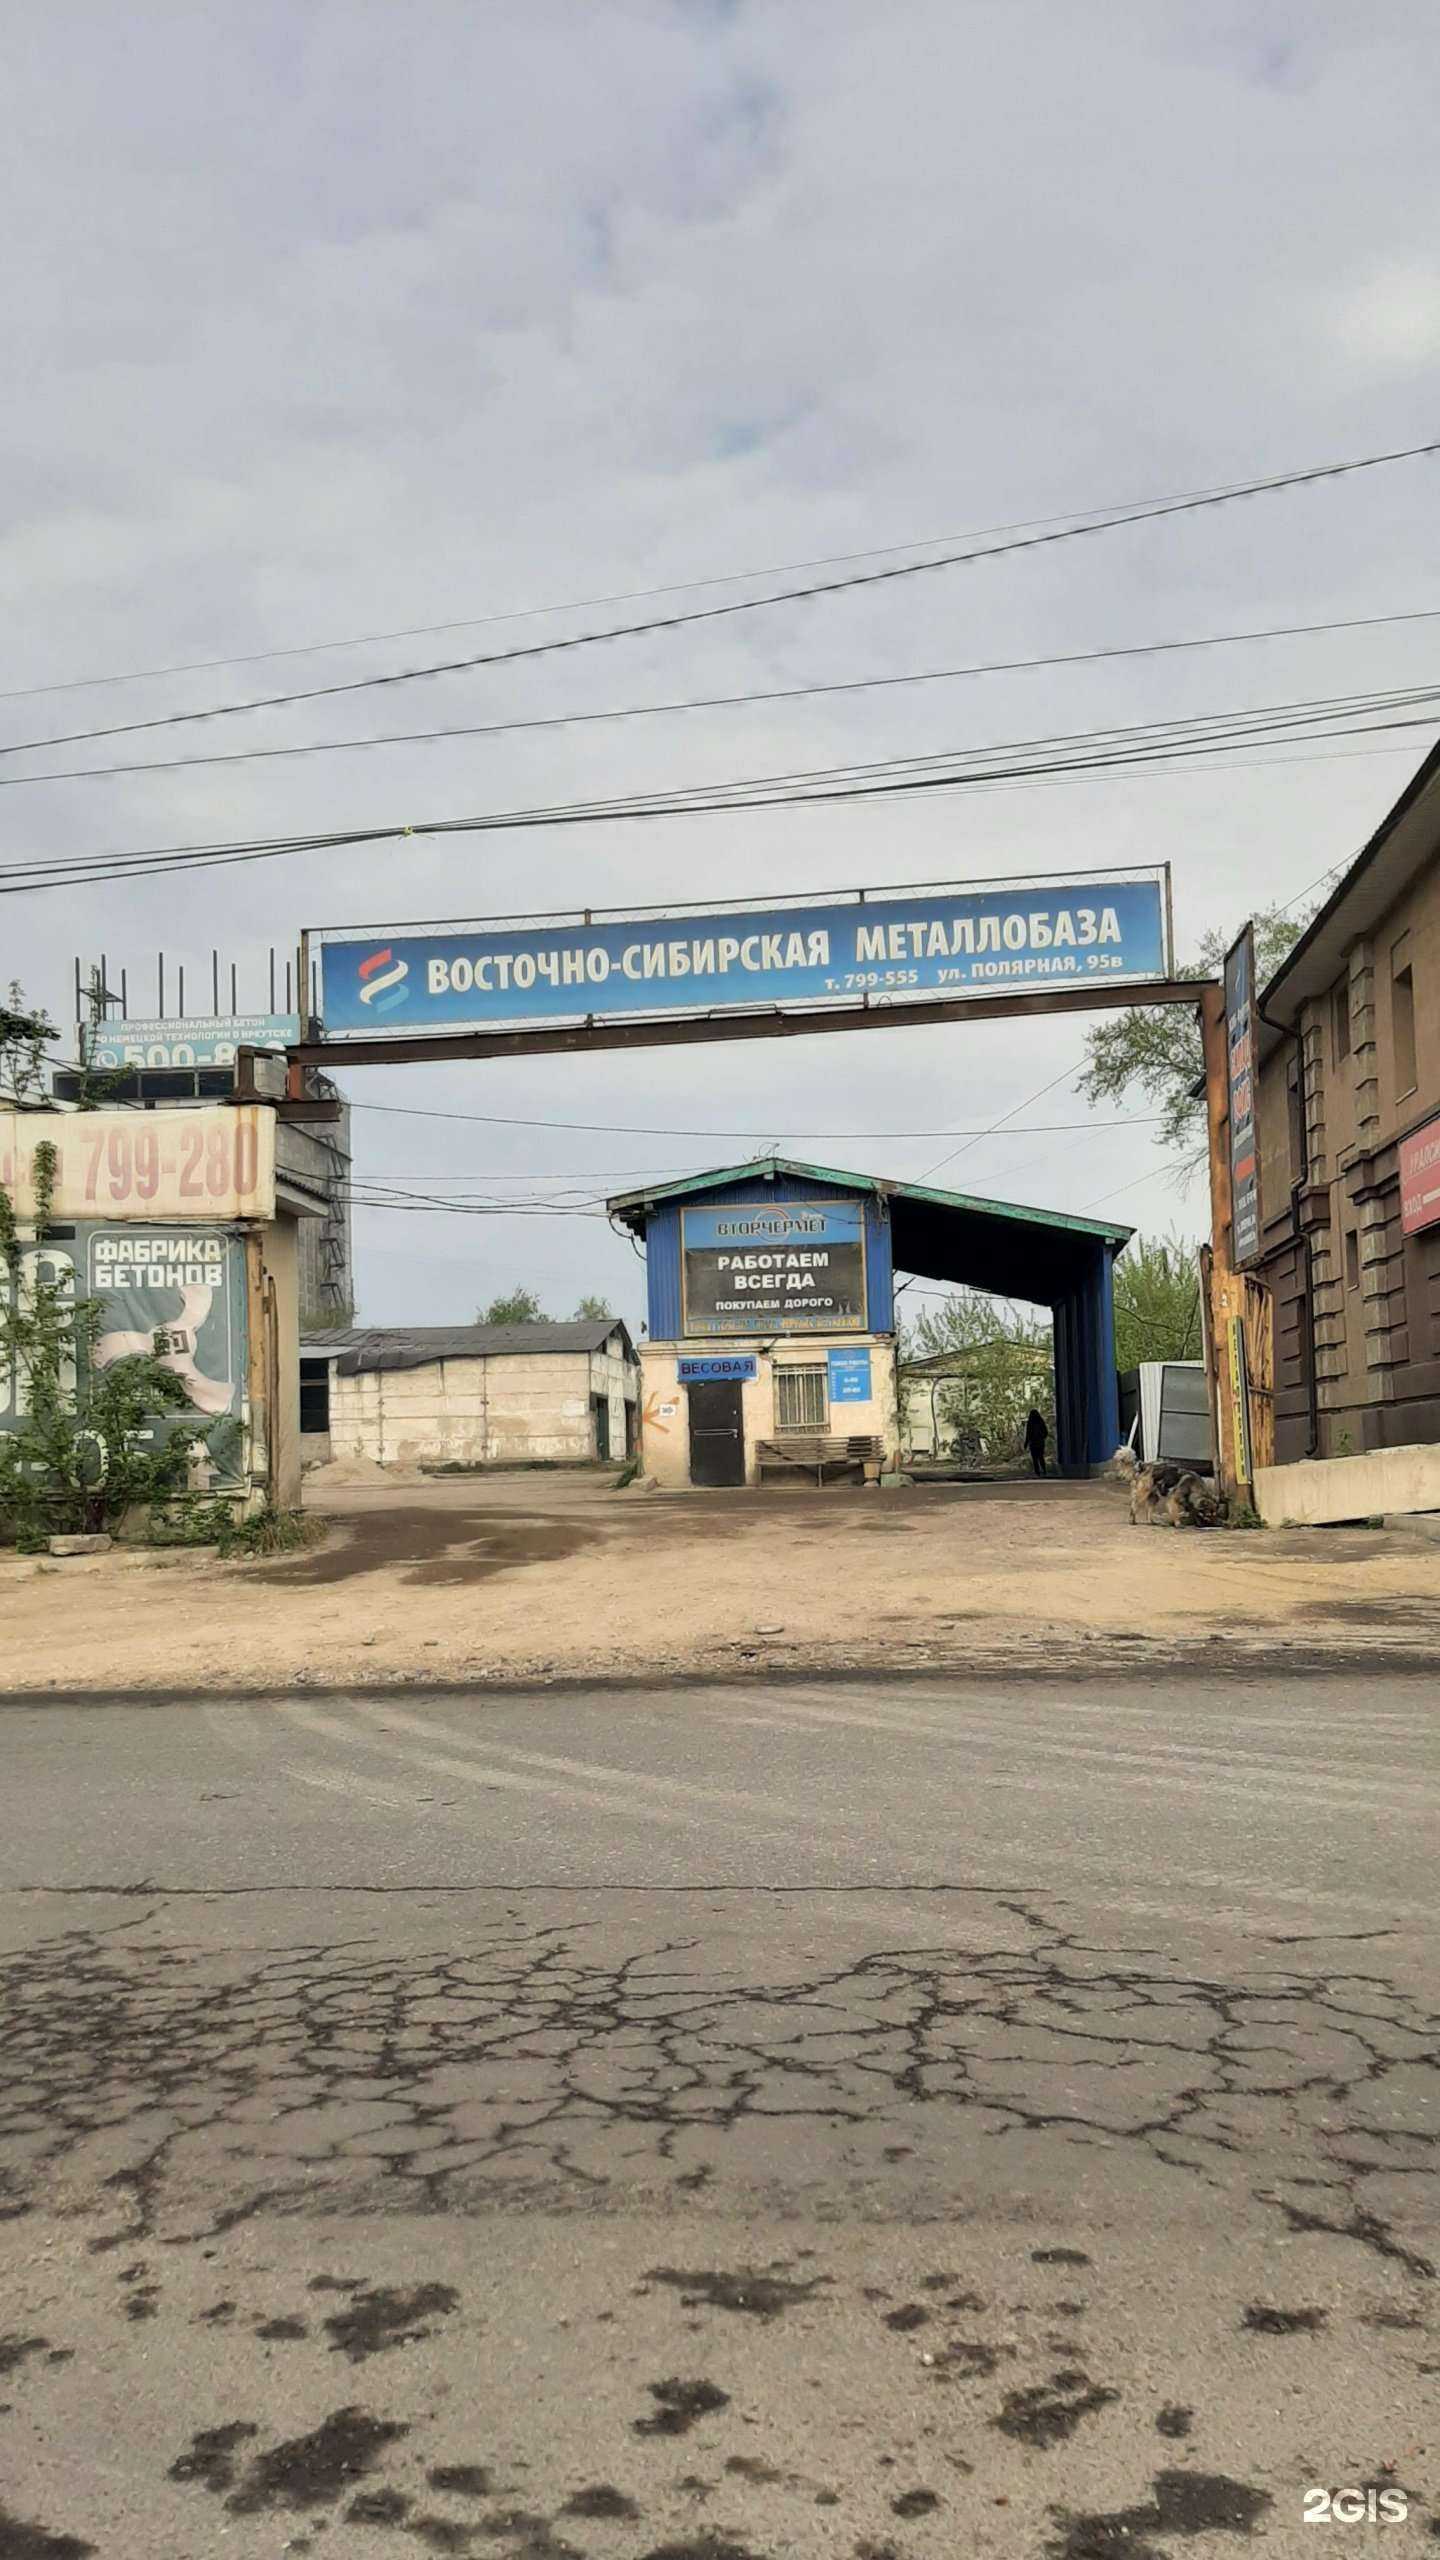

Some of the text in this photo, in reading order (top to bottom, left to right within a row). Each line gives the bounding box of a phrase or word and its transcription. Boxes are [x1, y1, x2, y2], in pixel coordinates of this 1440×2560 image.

[428, 907, 1122, 994] ВОСТОЧНО-СИБИРСКАЯ МЕТАЛЛОБАЗА
[825, 954, 1123, 990] т. 799-555 ул. ПОЛЯРНАЯ, 95в
[80, 1122, 258, 1200] 799-280
[716, 1219, 827, 1236] ВТОРЧЕРМЕТ
[95, 1240, 222, 1263] ФАБРИКА
[717, 1252, 829, 1271] РАБОТАЕМ
[95, 1264, 222, 1288] БЕТОНОВ
[734, 1272, 816, 1290] ВСЕГДА
[716, 1297, 833, 1311] ПОКУПАЕМ ДОРОГО
[680, 1360, 755, 1375] ВЕСОВАЯ
